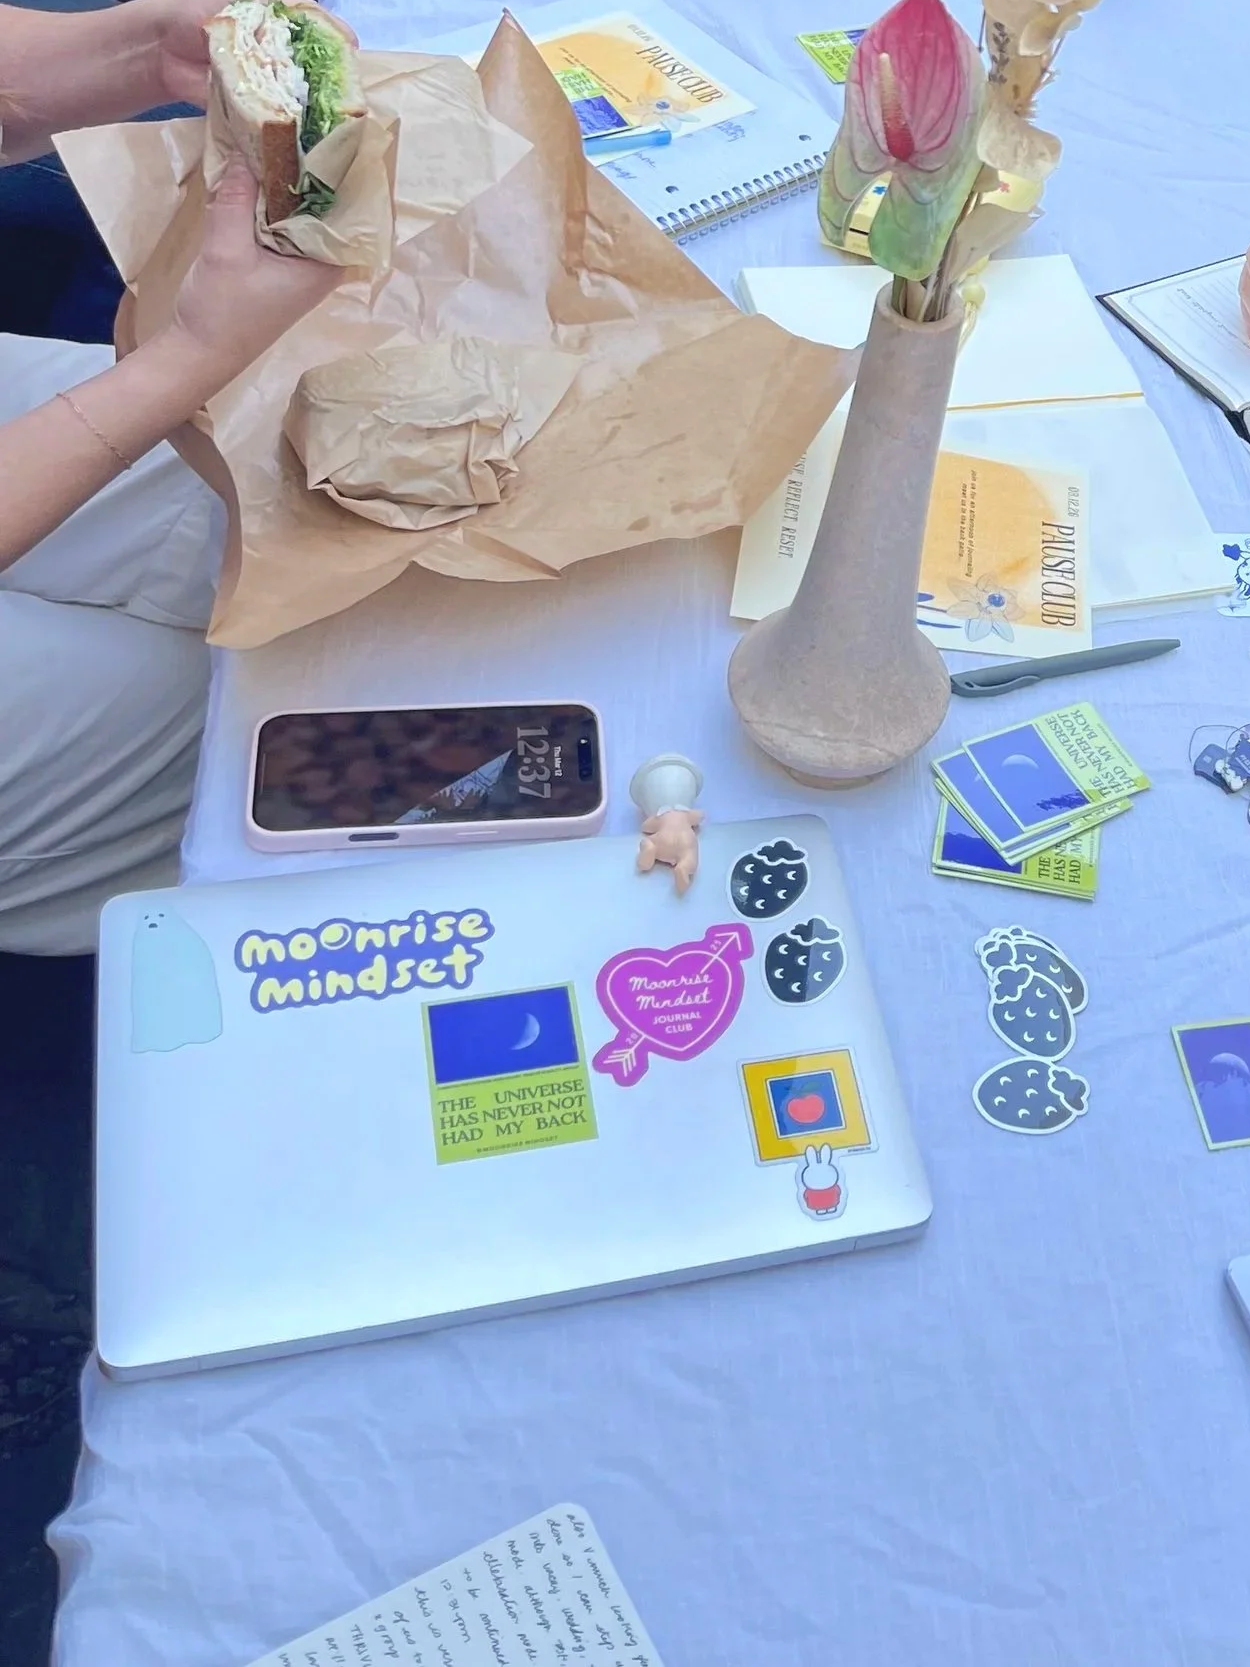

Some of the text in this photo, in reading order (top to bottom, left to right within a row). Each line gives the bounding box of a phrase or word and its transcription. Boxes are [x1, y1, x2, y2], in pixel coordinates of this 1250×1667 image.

[636, 43, 692, 81] PAUSE
[676, 73, 724, 106] CLUB
[777, 455, 806, 559] USE. REFLECT. RESET.
[1038, 521, 1077, 627] PAUSE CLUB
[1056, 708, 1080, 739] NOT
[1070, 706, 1098, 742] BACK
[516, 725, 551, 799] 12:37
[553, 746, 561, 756] Thu
[1044, 711, 1112, 801] THE UNIVERSE
[1074, 732, 1106, 775] NEVER
[1094, 740, 1114, 764] MY
[1101, 768, 1124, 796] HAS
[1112, 761, 1136, 791] HAD
[1037, 855, 1050, 878] THE
[1053, 858, 1066, 881] HAS
[1068, 859, 1081, 883] HAD
[242, 911, 489, 966] moonrise
[258, 946, 479, 1005] mindset
[628, 968, 713, 991] Moonrise
[652, 1010, 701, 1025] JOURNAL
[665, 1023, 693, 1034] CLUB
[436, 1078, 585, 1114] THE UNIVERSE
[438, 1093, 587, 1130] HAS NEVER NOT
[441, 1109, 587, 1146] HAD MY BACK
